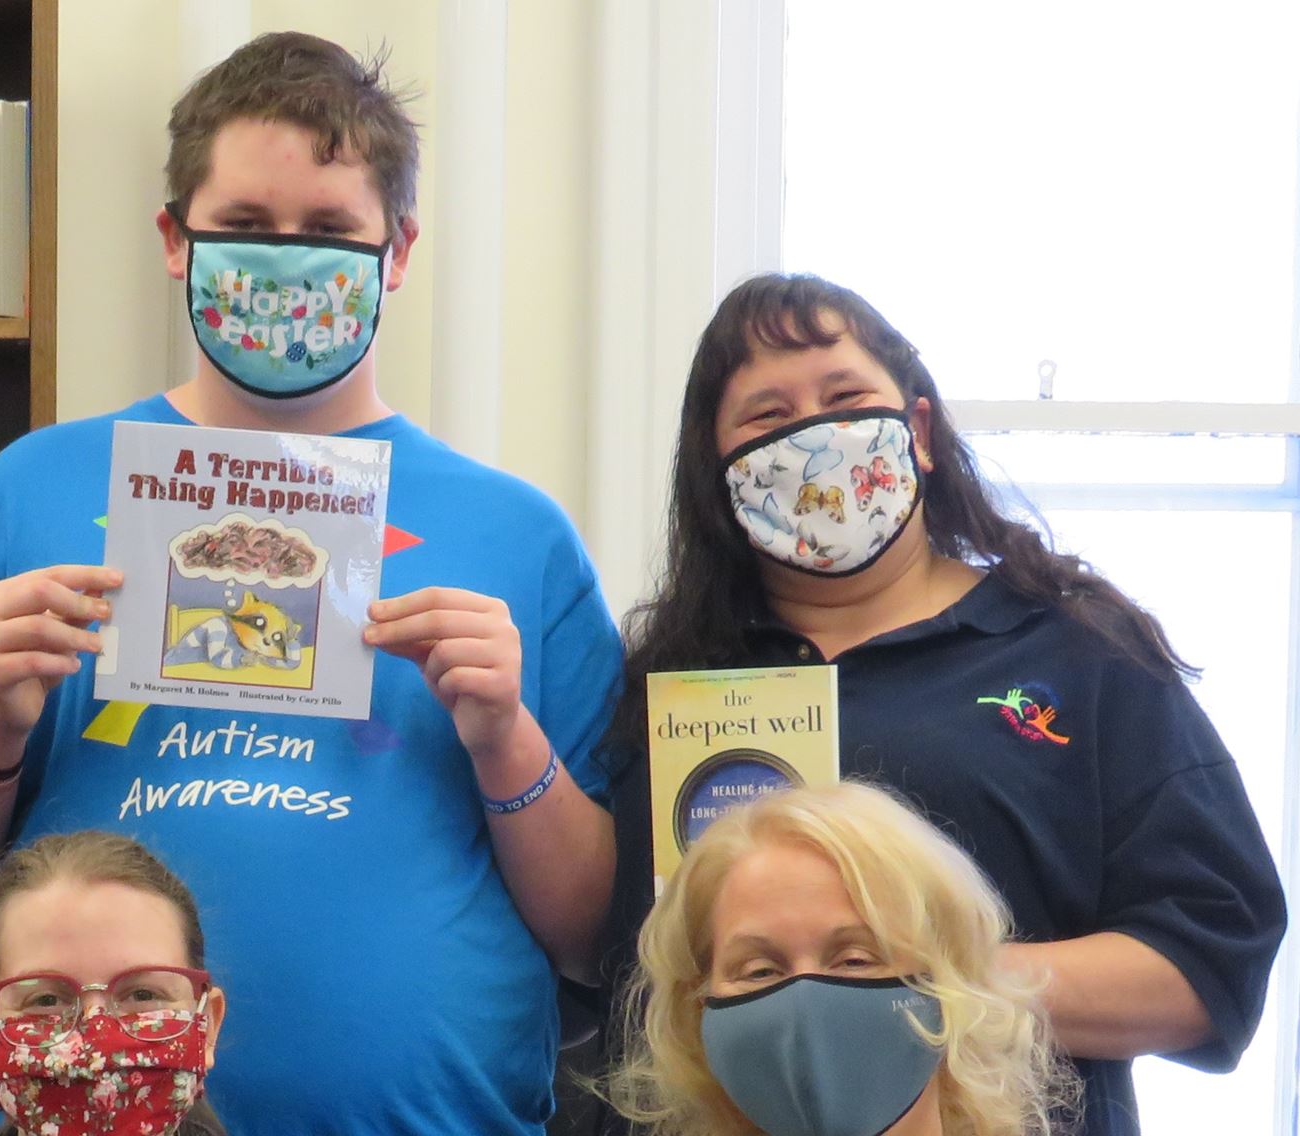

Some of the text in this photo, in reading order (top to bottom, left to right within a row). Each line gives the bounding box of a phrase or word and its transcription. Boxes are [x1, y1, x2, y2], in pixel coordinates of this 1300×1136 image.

[174, 449, 335, 486] A Terrible
[128, 474, 376, 516] Thing Happened
[130, 682, 342, 706] By Margaret M. Holmes Illustrated by Cary Pillo
[724, 689, 753, 707] the
[157, 720, 315, 762] Autism
[658, 705, 824, 746] deepest well
[119, 777, 352, 820] Awareness
[505, 800, 521, 811] TO
[523, 785, 544, 804] END
[712, 784, 755, 798] HEALING
